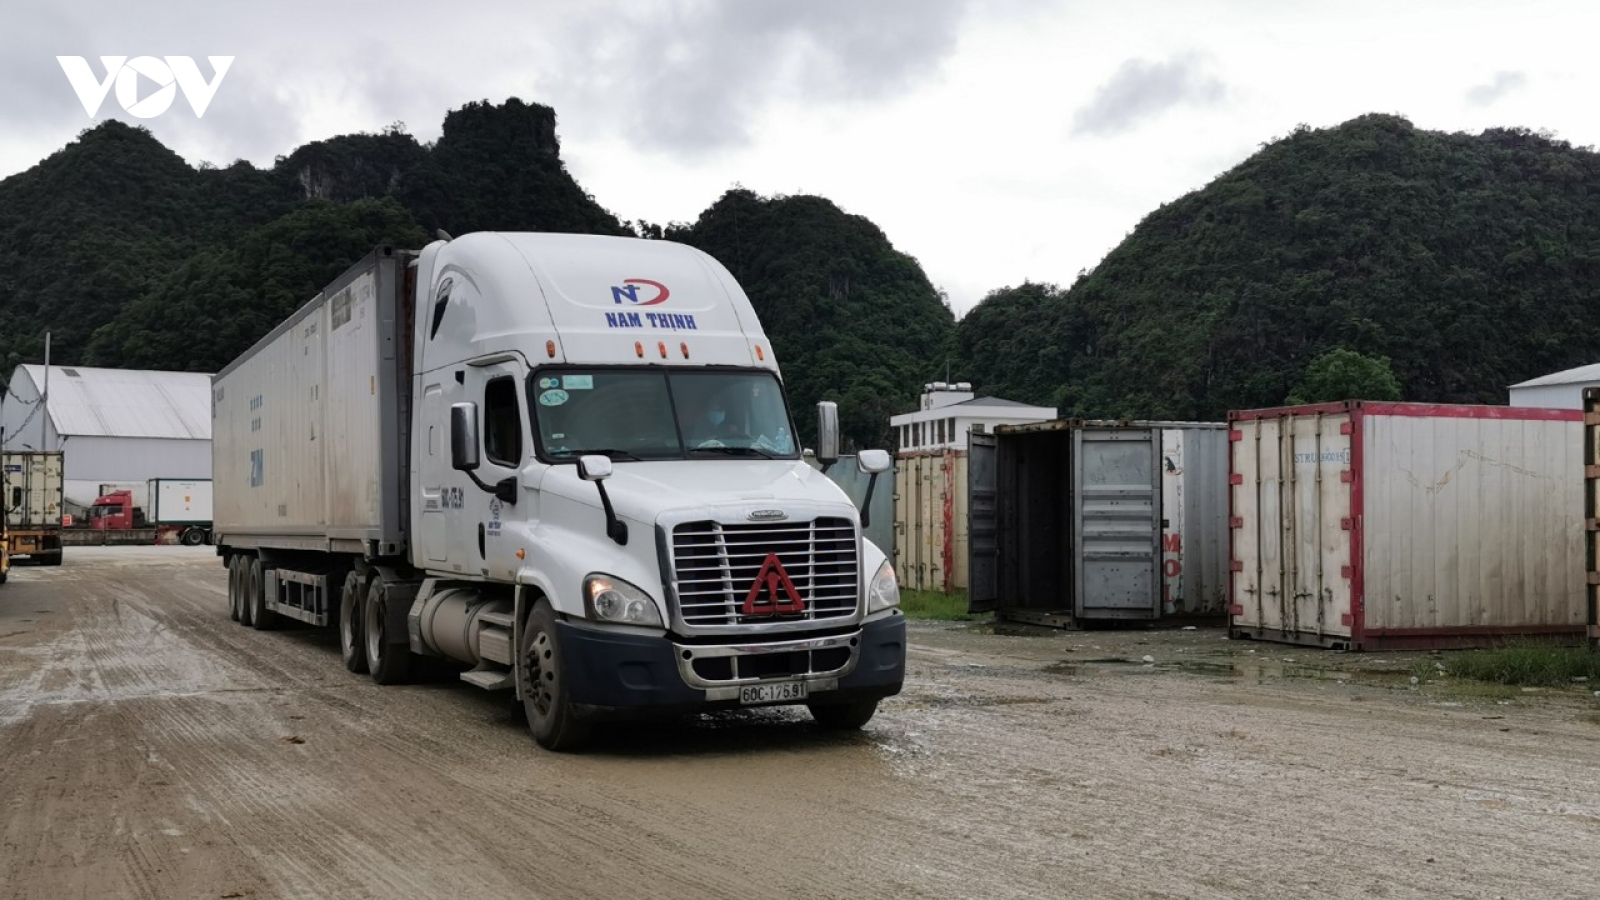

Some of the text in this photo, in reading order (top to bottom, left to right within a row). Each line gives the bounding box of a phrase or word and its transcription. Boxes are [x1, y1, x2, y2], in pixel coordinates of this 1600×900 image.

[604, 312, 698, 331] NAM THỊNH
[743, 683, 806, 702] 60C-175.91
